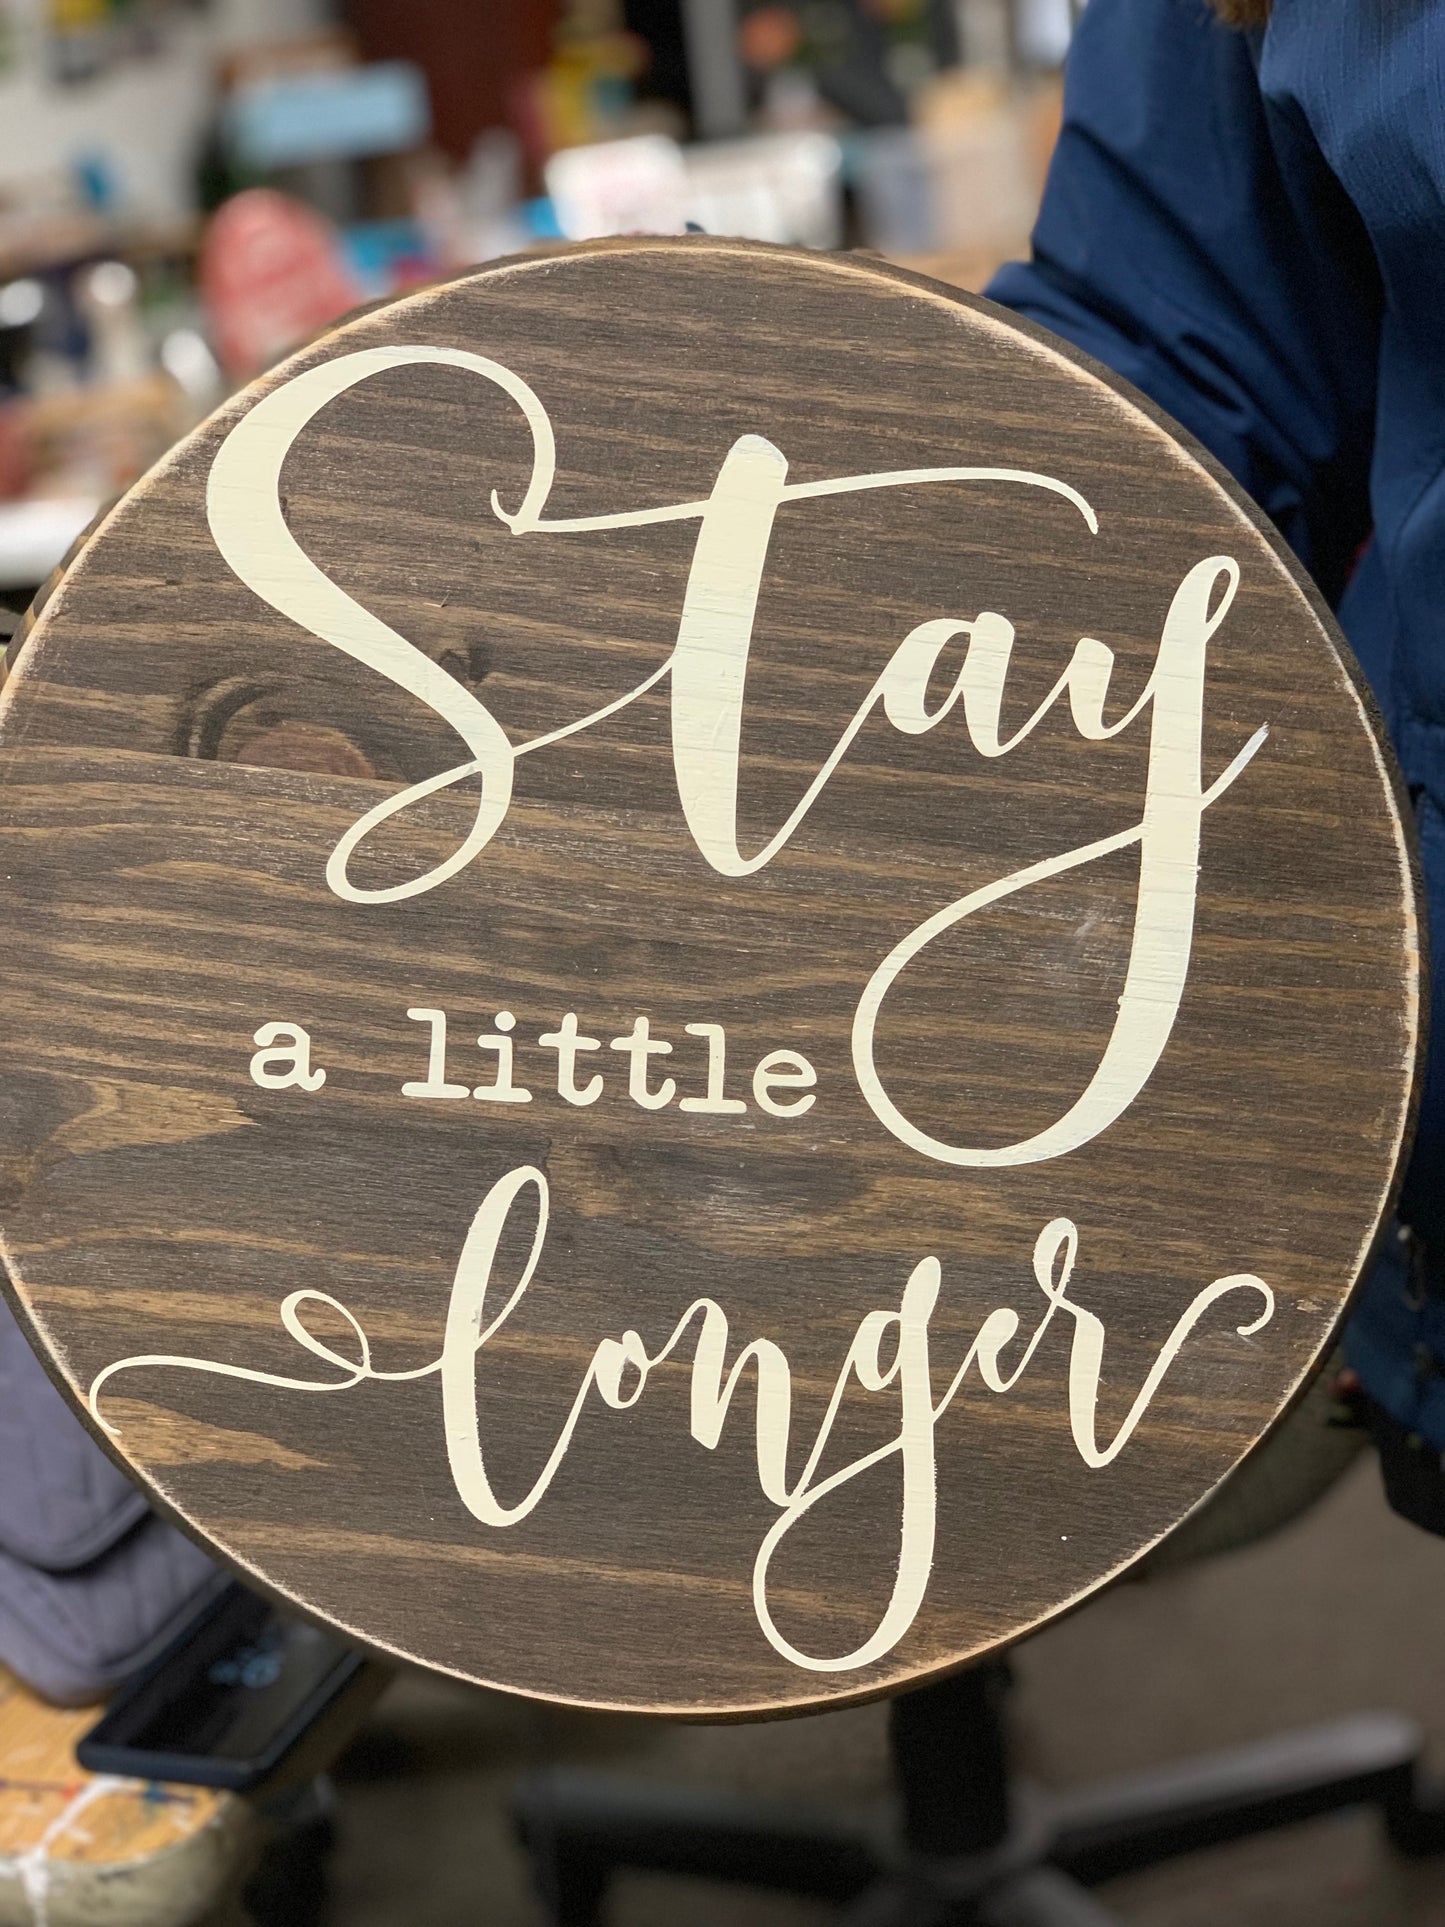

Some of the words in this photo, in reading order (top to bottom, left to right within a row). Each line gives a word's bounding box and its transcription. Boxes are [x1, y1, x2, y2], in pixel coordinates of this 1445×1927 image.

[206, 344, 1269, 1168] Stay
[249, 1021, 327, 1092] a
[401, 1008, 818, 1118] little
[90, 1165, 1275, 1672] longer
